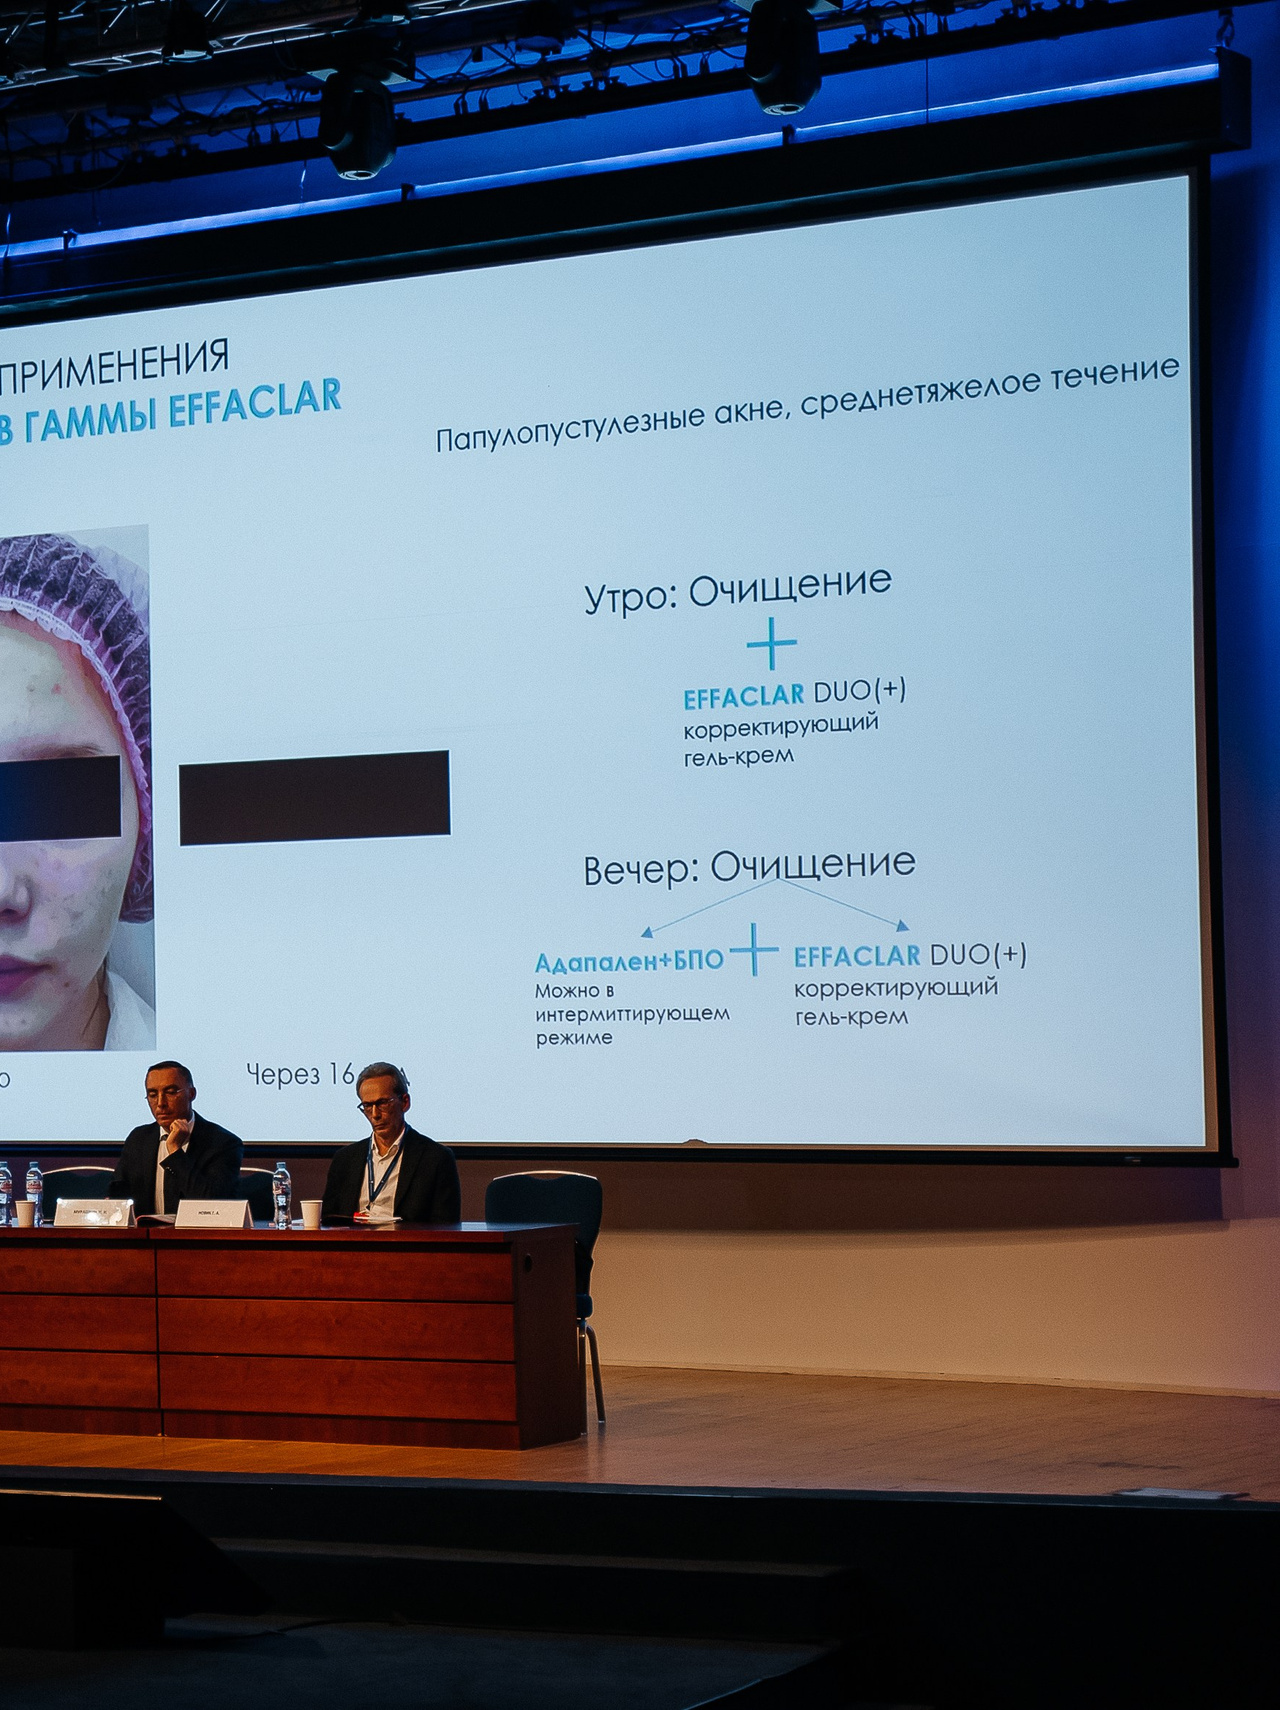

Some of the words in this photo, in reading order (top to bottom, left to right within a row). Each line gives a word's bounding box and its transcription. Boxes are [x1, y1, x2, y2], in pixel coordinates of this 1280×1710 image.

[26, 398, 156, 443] ГАММЫ
[170, 377, 342, 428] EFFACLAR
[437, 408, 705, 453] Папулопустулезные
[715, 400, 790, 424] акне,
[801, 373, 1041, 420] среднетяжелое
[1051, 358, 1179, 389] течение
[585, 584, 676, 619] Утро:
[690, 569, 892, 607] Очищение
[684, 683, 804, 711] EFFACLAR
[815, 676, 905, 704] DUO(+)
[684, 711, 878, 742] корректирующий
[685, 749, 794, 768] гель-крем
[585, 856, 698, 890] Вечер:
[712, 850, 915, 882] Очищение
[535, 949, 724, 975] Адапален+БПО
[795, 945, 920, 967] EFFACLAR
[931, 942, 1026, 969] DUO(+)
[535, 984, 600, 998] Можно
[606, 985, 615, 998] в
[795, 976, 998, 1001] корректирующий
[536, 1008, 730, 1025] интермиттирующем
[796, 1011, 908, 1029] гель-крем
[537, 1033, 612, 1049] режиме
[247, 1063, 320, 1090] Через
[330, 1062, 354, 1084] 16
